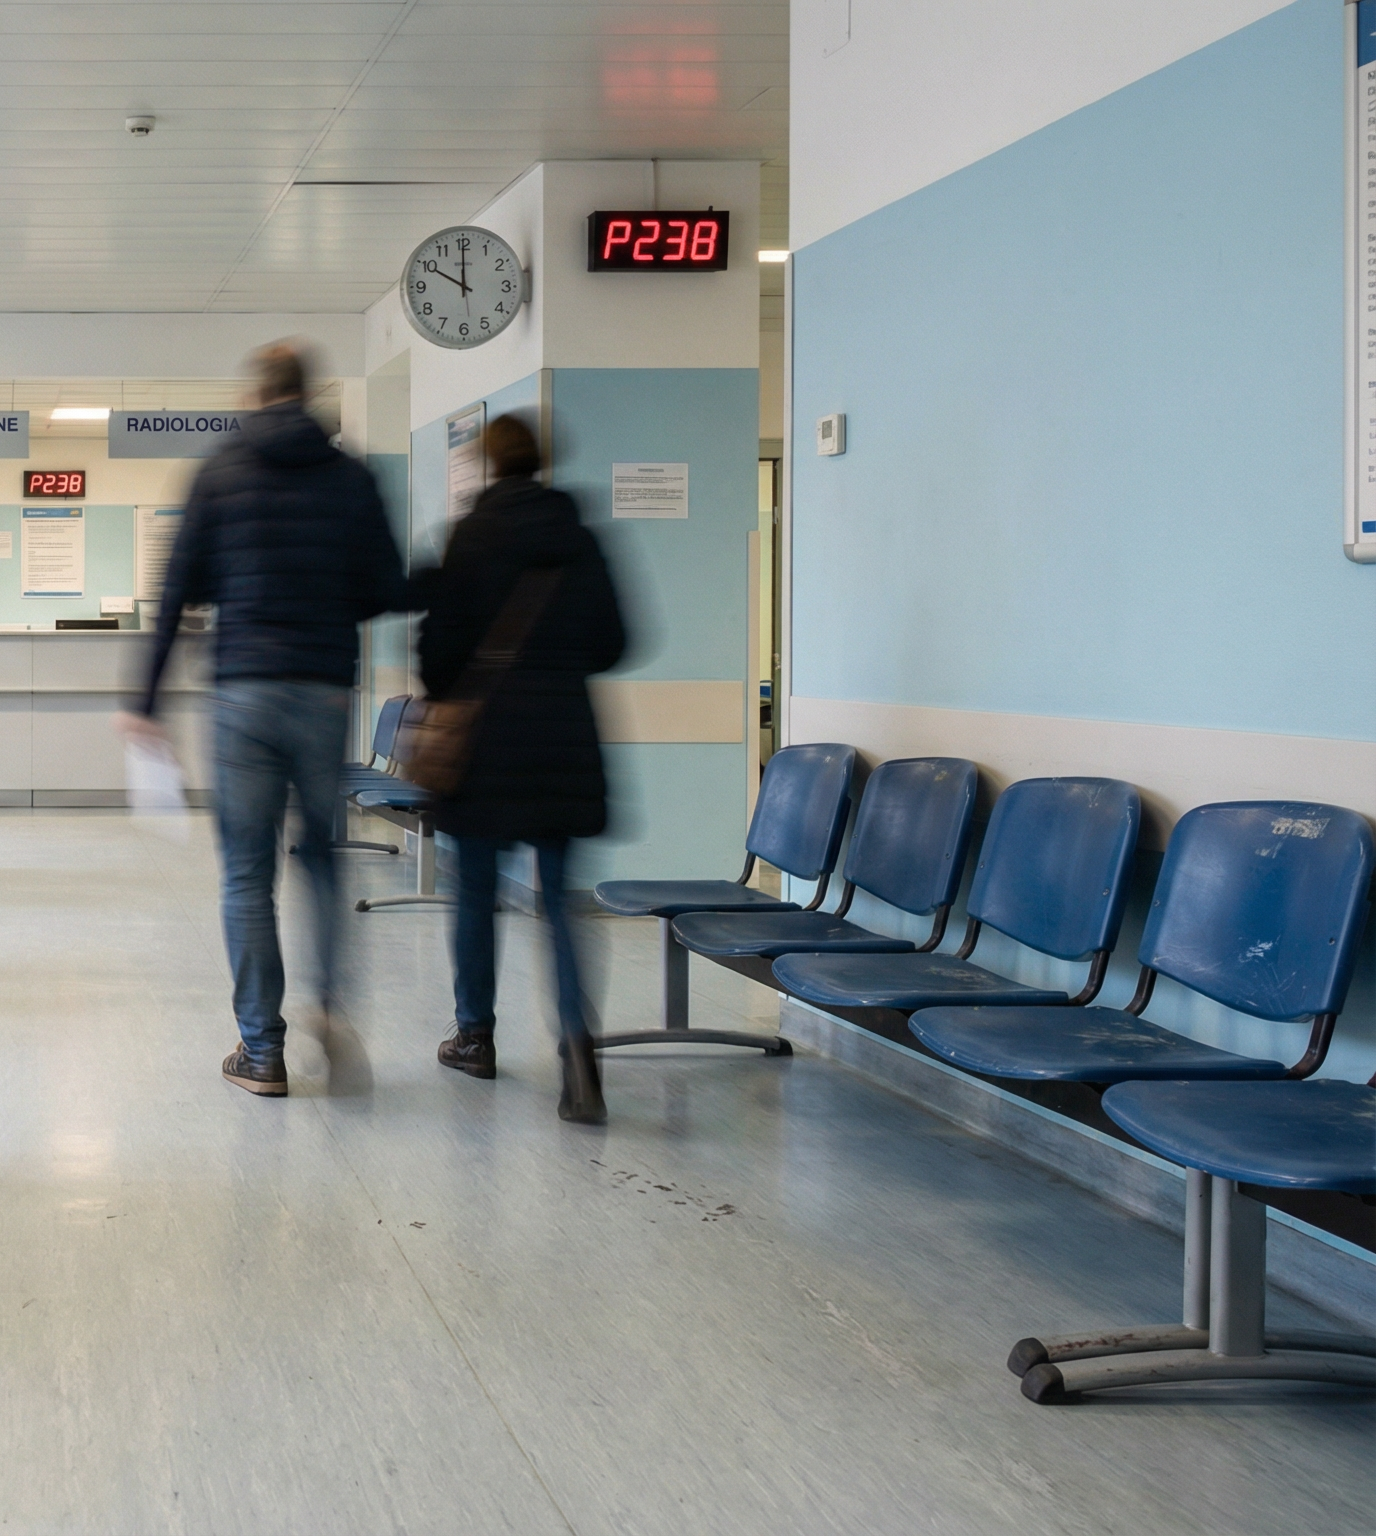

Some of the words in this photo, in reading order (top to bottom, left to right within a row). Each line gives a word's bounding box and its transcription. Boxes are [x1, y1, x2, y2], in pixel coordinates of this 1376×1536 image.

[455, 238, 471, 251] 12
[604, 221, 719, 260] P238
[435, 244, 448, 257] 11
[482, 244, 488, 257] 1
[422, 260, 437, 273] 10
[494, 258, 505, 272] 2
[415, 280, 427, 294] 9
[500, 280, 512, 293] 3
[422, 302, 433, 316] 8
[494, 301, 504, 314] 4
[438, 316, 449, 330] 7
[458, 322, 470, 336] 6
[479, 316, 490, 330] 5
[126, 417, 242, 432] RADIOLOGIA
